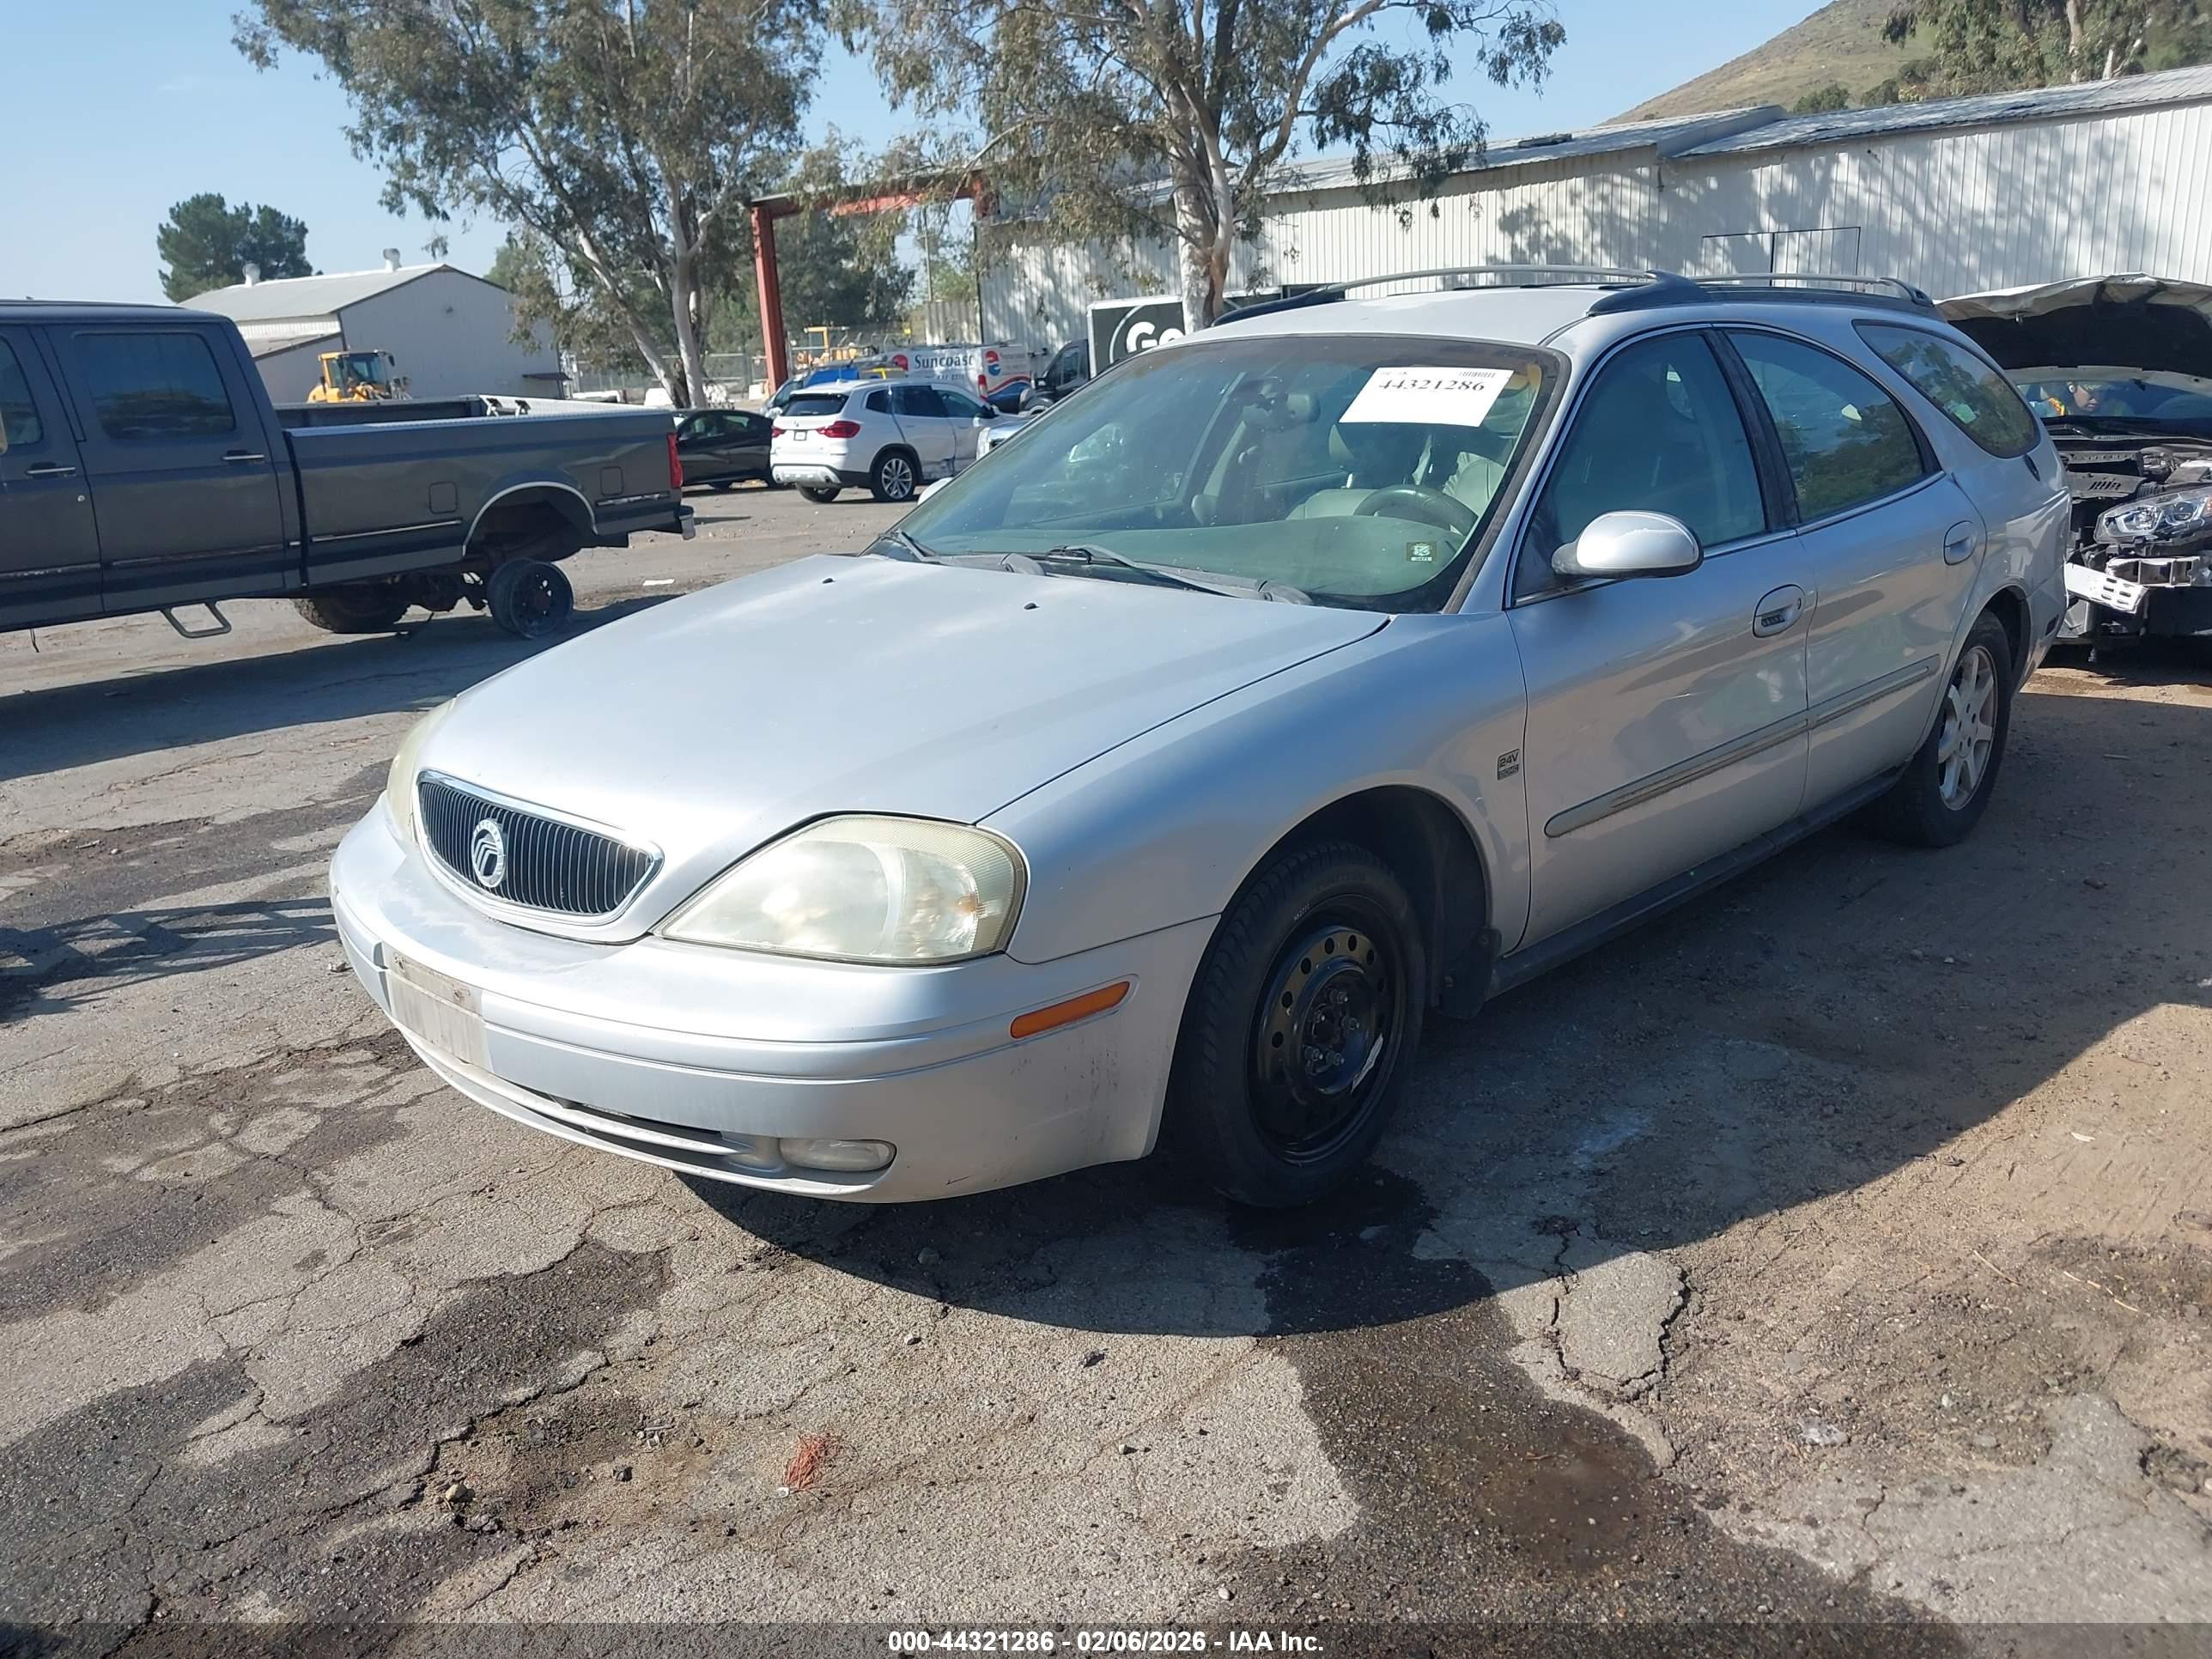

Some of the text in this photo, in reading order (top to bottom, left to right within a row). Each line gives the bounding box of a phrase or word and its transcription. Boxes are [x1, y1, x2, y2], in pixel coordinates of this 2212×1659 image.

[915, 354, 974, 369] Suncoast
[1379, 379, 1485, 392] 44321286
[1499, 751, 1519, 768] 24V
